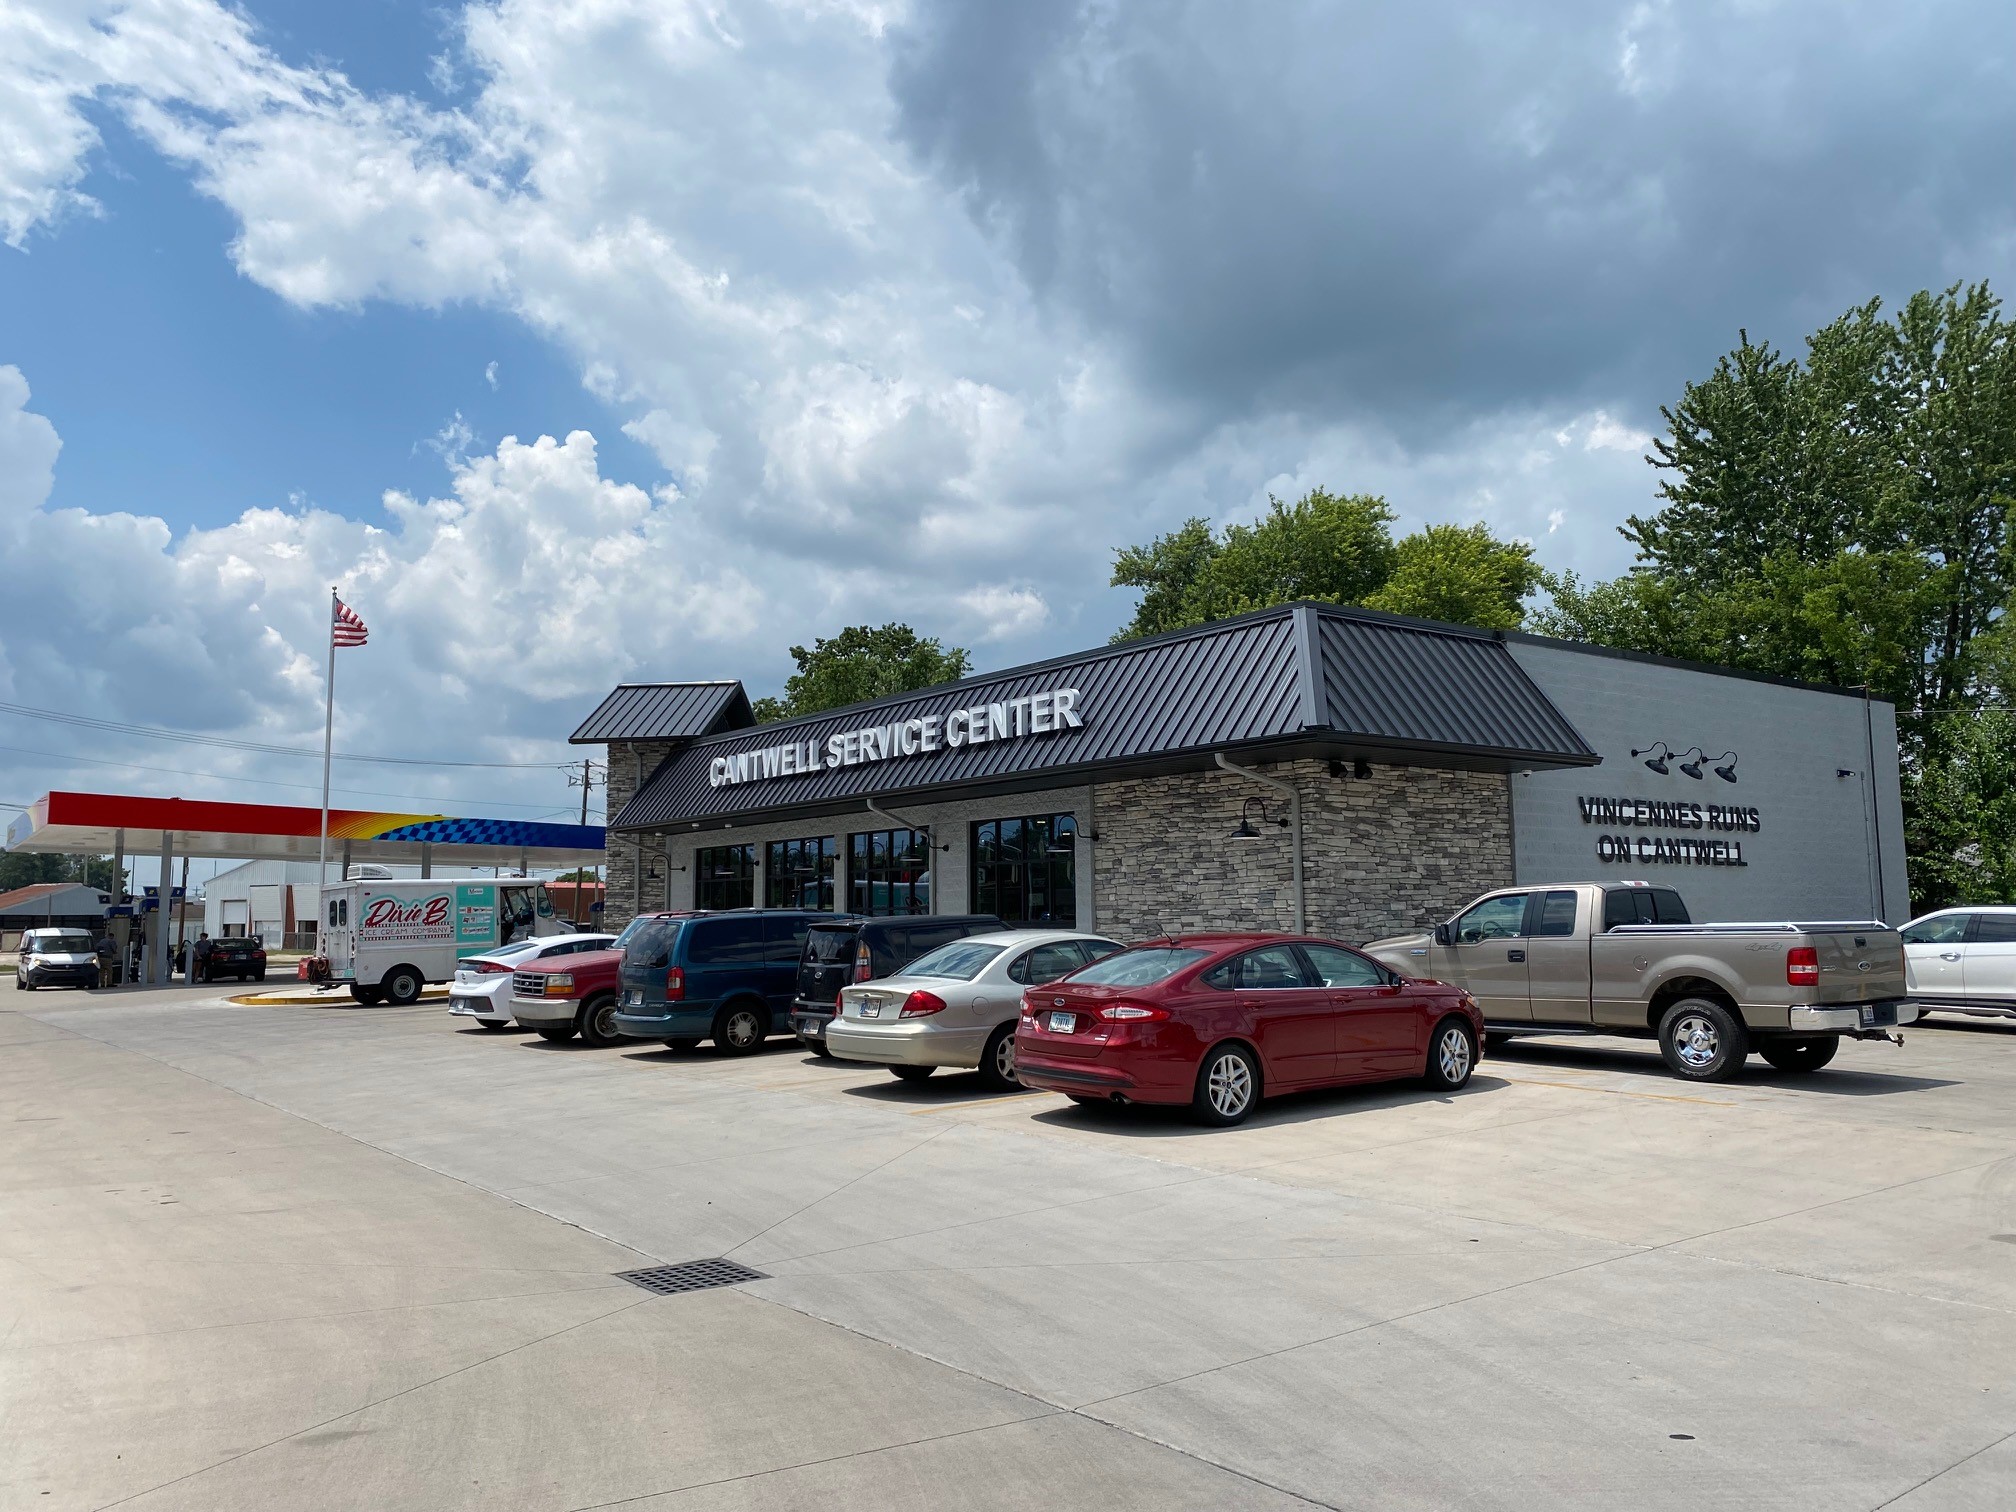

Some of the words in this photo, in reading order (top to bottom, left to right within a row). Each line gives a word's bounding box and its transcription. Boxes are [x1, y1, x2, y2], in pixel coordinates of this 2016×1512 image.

[709, 739, 825, 787] CANTWELL
[826, 714, 942, 768] SERVICE
[946, 688, 1083, 748] CENTER
[1578, 796, 1703, 830] VINCENNES
[1708, 804, 1761, 833] RUNS
[1599, 835, 1631, 864] ON
[1637, 836, 1748, 867] CANTWELL
[365, 899, 423, 928] Dixie
[422, 897, 450, 926] B
[365, 928, 376, 936] ICE
[380, 928, 408, 936] CREAM
[411, 926, 448, 935] COMPANY
